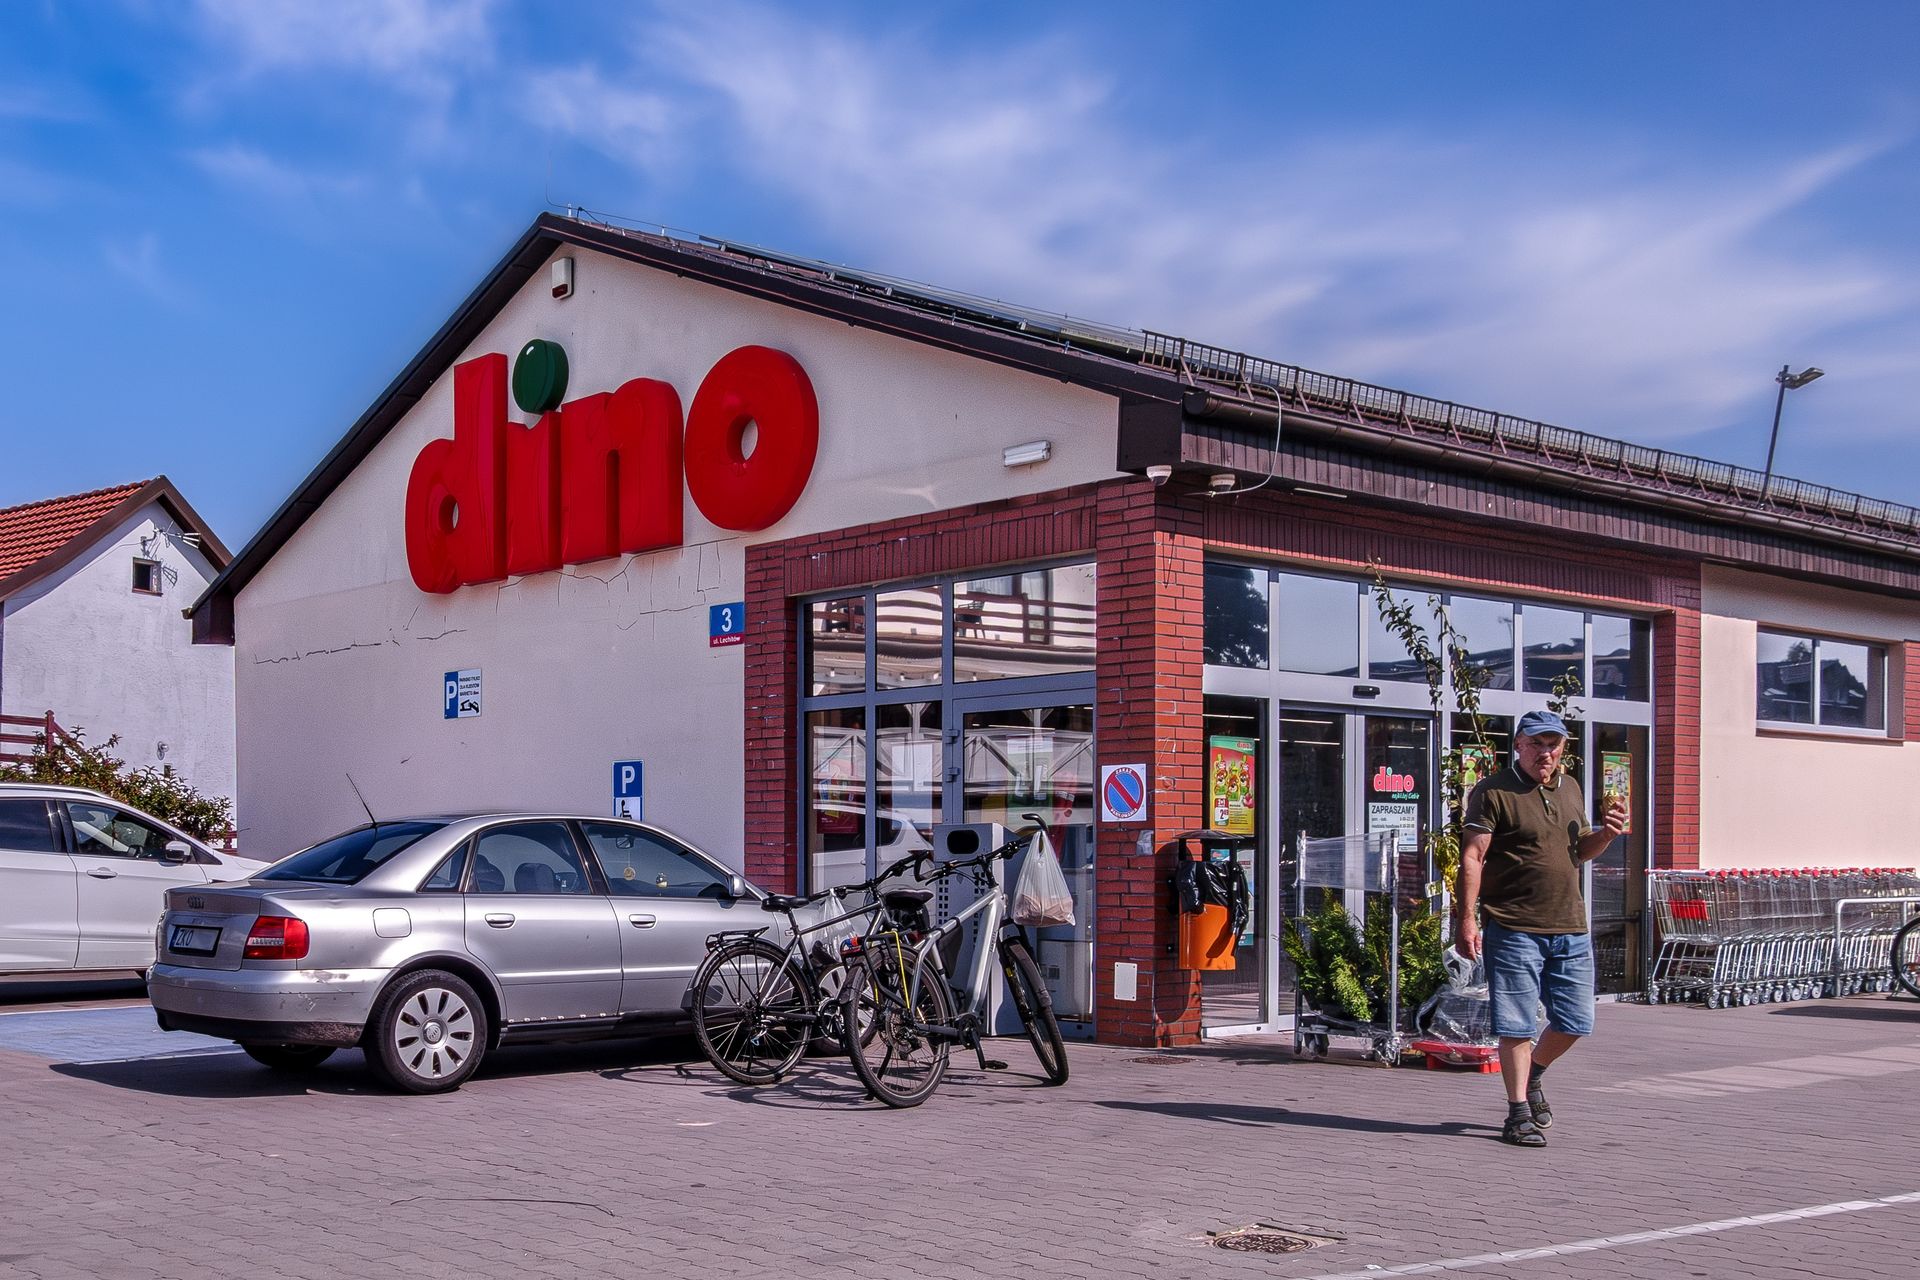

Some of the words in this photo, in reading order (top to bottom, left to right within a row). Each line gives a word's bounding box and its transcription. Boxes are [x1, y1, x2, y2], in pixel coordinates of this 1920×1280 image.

[405, 338, 820, 595] dino
[721, 607, 732, 632] 3
[446, 681, 458, 710] P
[621, 765, 636, 794] P
[1373, 766, 1414, 792] dino
[1371, 805, 1415, 814] ZAPRASZAMY
